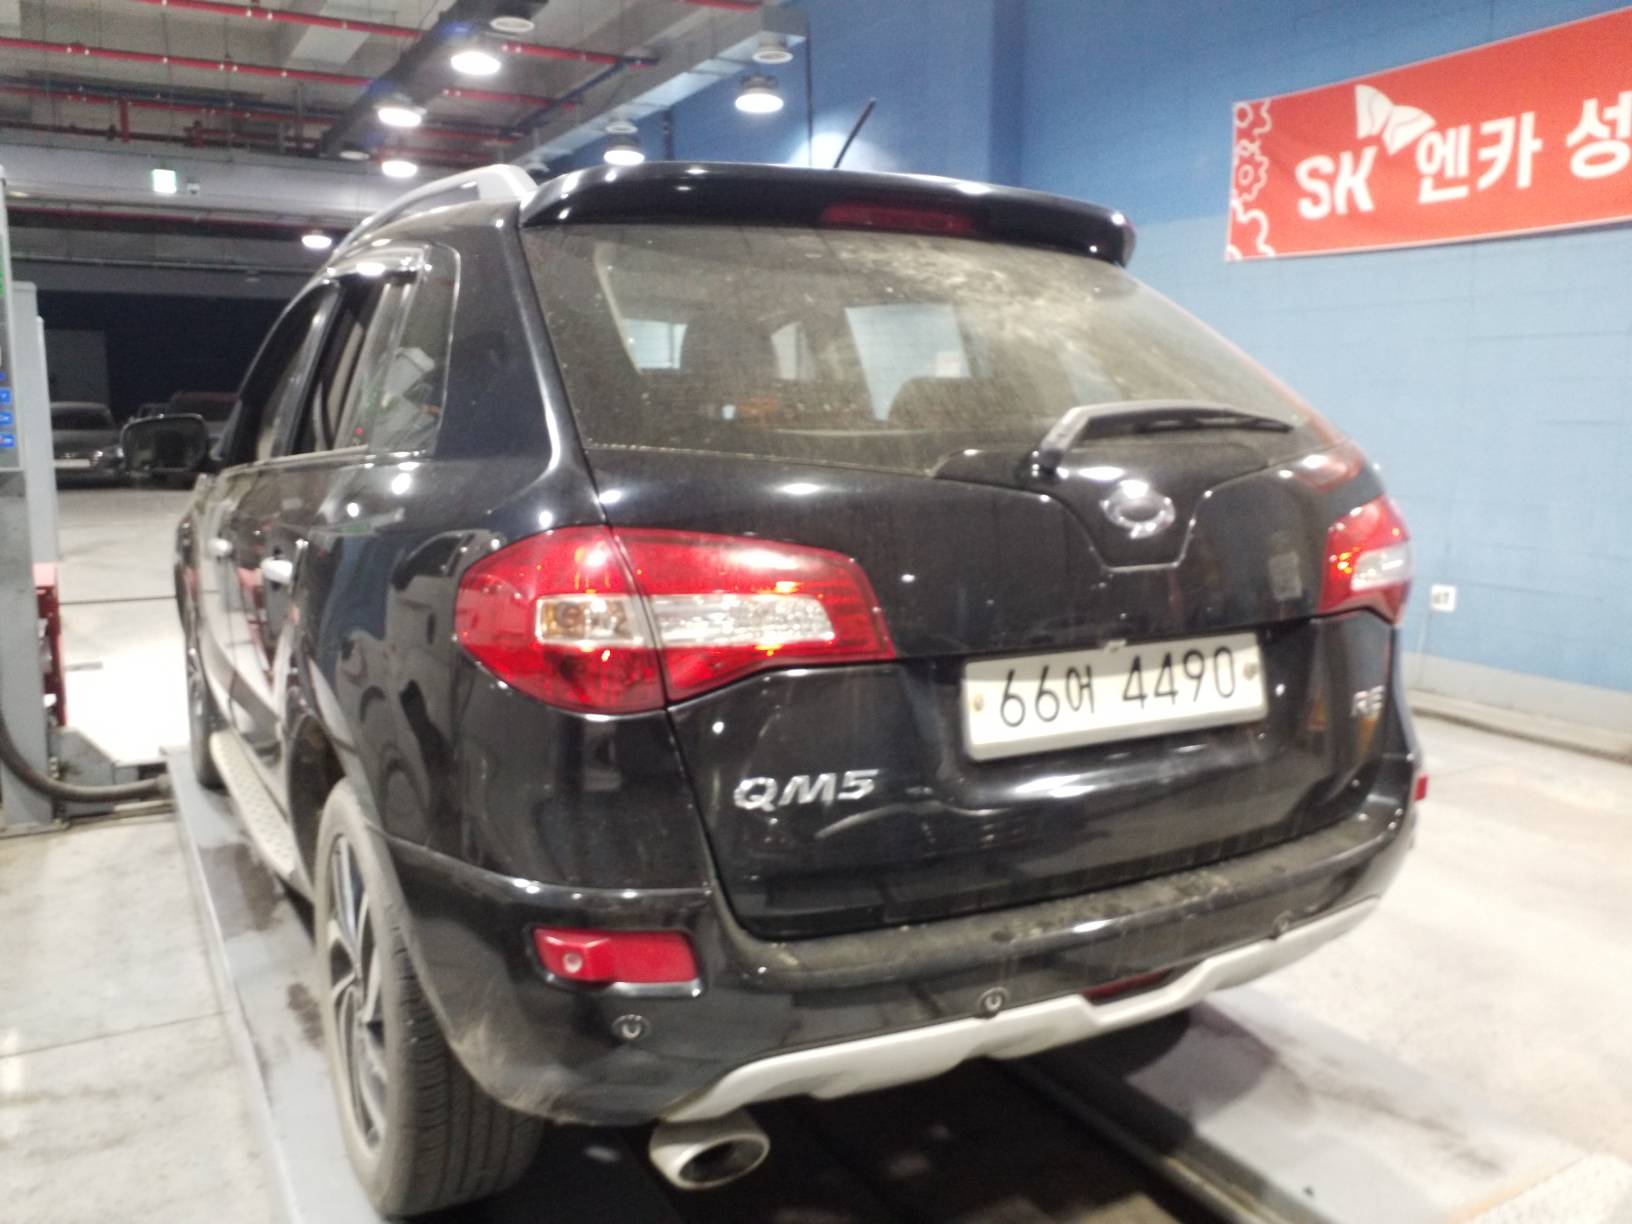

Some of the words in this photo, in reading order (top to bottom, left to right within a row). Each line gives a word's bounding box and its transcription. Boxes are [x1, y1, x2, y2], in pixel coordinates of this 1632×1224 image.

[1295, 145, 1378, 219] SK
[1415, 111, 1543, 204] 엔카
[999, 663, 1095, 727] 66어
[1121, 645, 1236, 709] 4490
[733, 768, 880, 811] QM5
